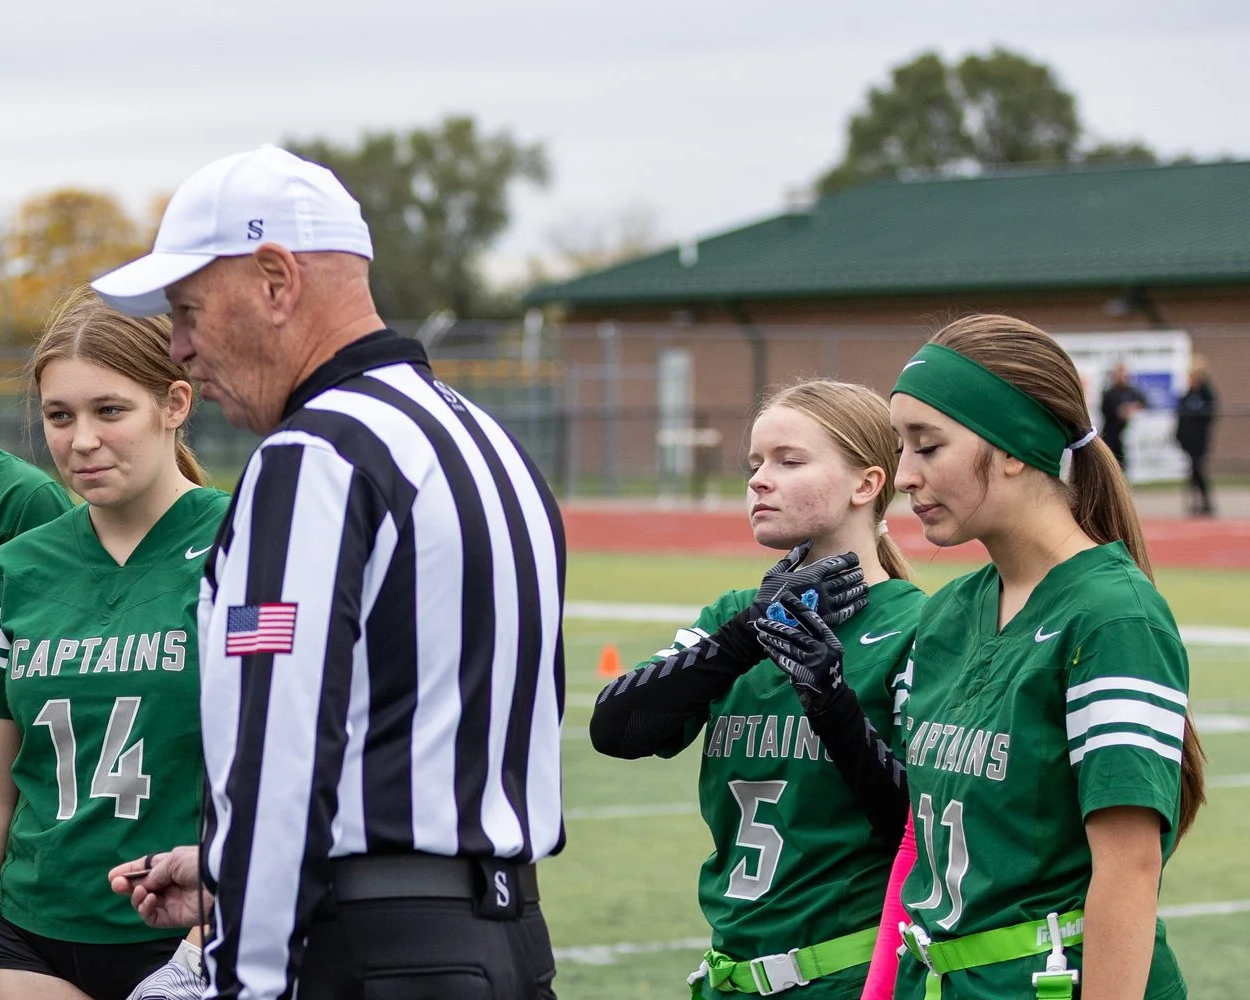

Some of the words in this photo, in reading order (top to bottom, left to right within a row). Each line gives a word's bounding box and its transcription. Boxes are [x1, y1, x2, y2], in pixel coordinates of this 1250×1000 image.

[10, 630, 187, 681] CAPTAINS
[32, 696, 152, 821] 14
[706, 714, 833, 763] APTAIN
[723, 779, 789, 902] 5
[906, 793, 970, 931] 11
